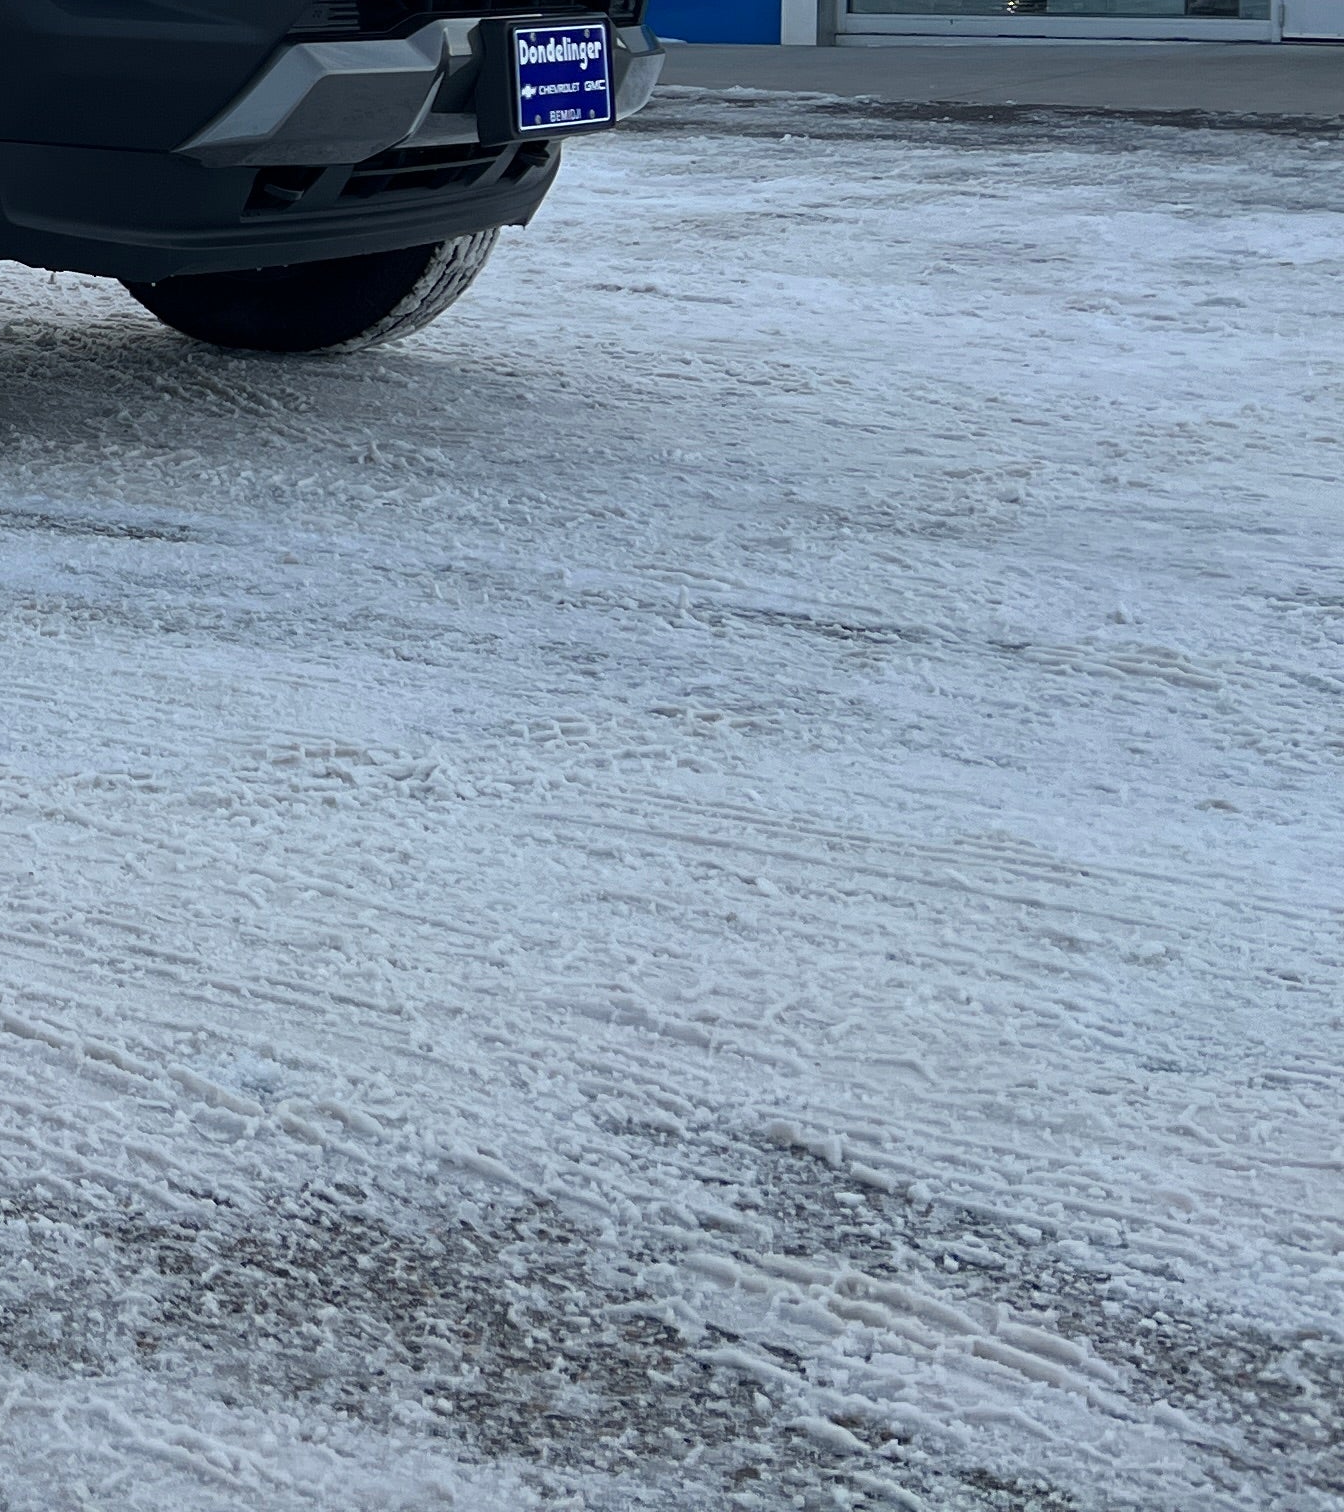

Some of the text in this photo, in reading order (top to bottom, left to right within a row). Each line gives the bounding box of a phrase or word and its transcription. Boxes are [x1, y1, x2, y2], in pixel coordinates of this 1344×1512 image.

[518, 37, 602, 70] Dondelinger
[538, 79, 607, 96] CHEVROLET GMC
[549, 108, 582, 123] BEMIDJI
